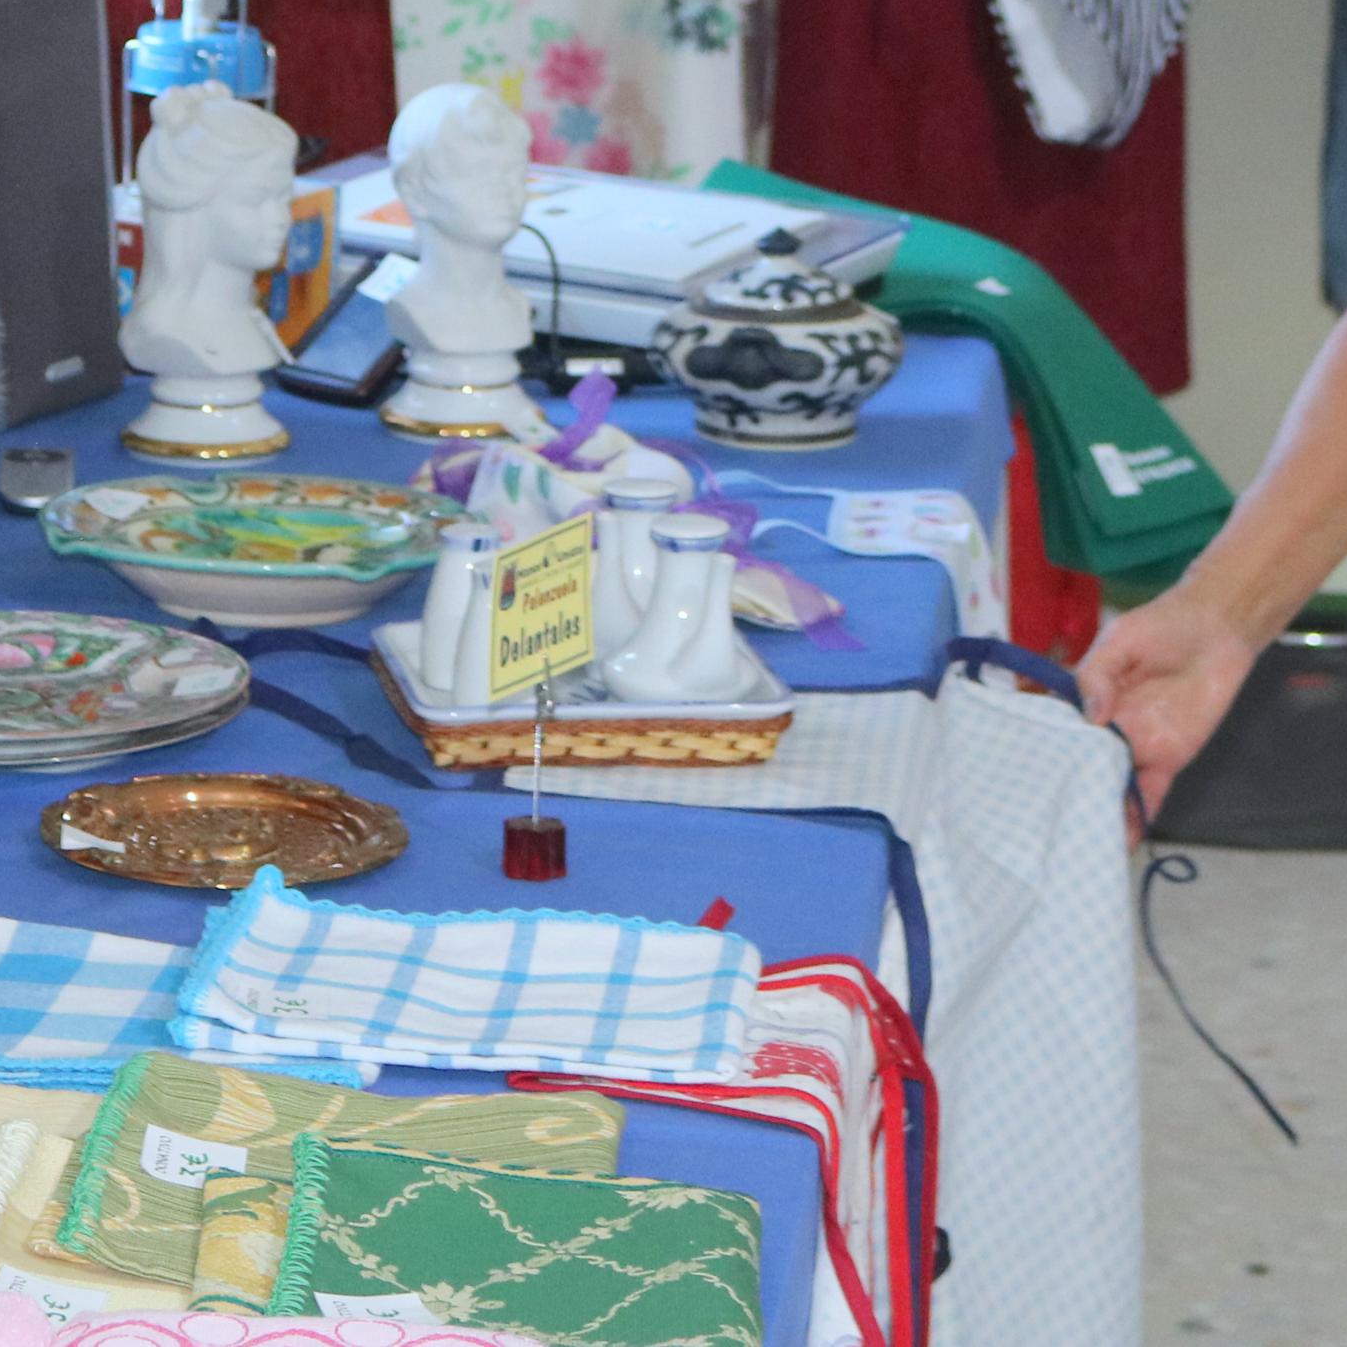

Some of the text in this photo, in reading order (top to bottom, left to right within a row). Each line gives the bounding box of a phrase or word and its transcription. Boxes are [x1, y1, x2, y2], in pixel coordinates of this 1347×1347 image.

[500, 611, 581, 668] Delantales
[272, 997, 309, 1014] 3€
[154, 1134, 172, 1174] DONATIVO
